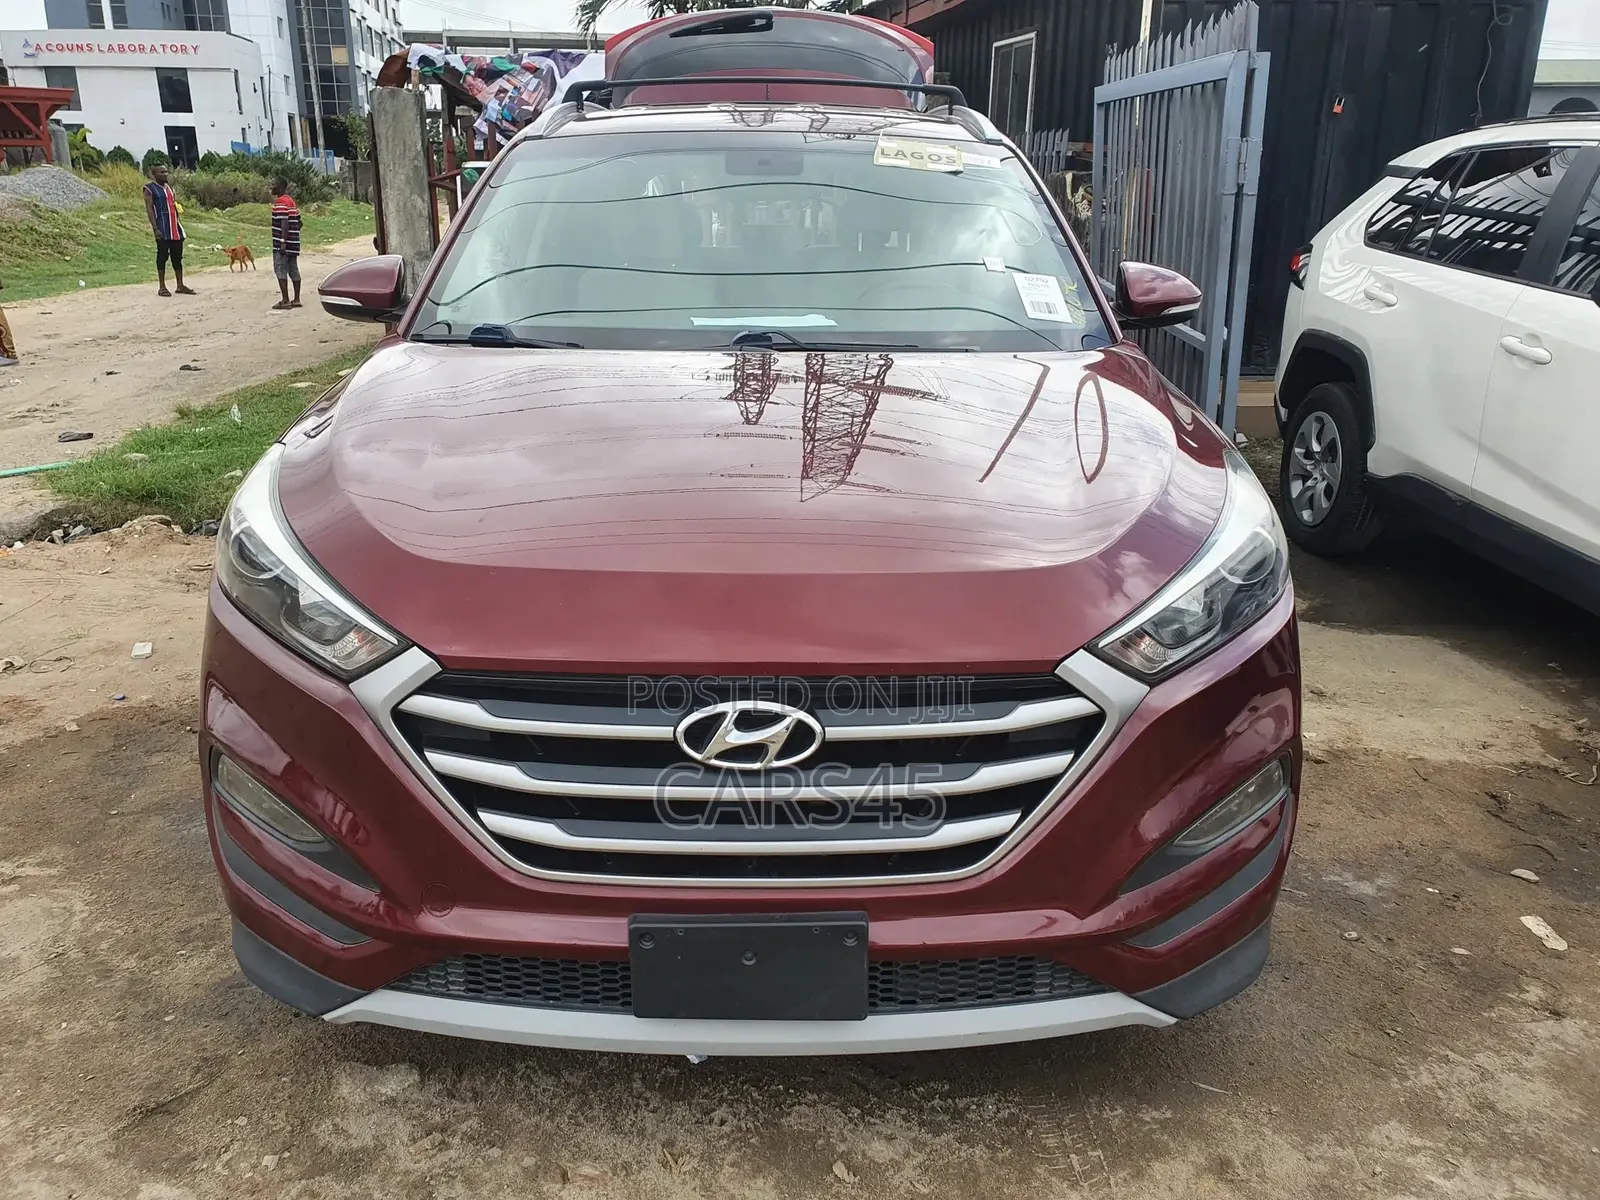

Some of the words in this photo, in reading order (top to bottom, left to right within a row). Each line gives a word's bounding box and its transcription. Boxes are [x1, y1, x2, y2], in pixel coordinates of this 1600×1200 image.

[34, 42, 93, 54] ACOUNS
[97, 43, 200, 55] LABORATORY
[880, 147, 957, 164] LAGOS
